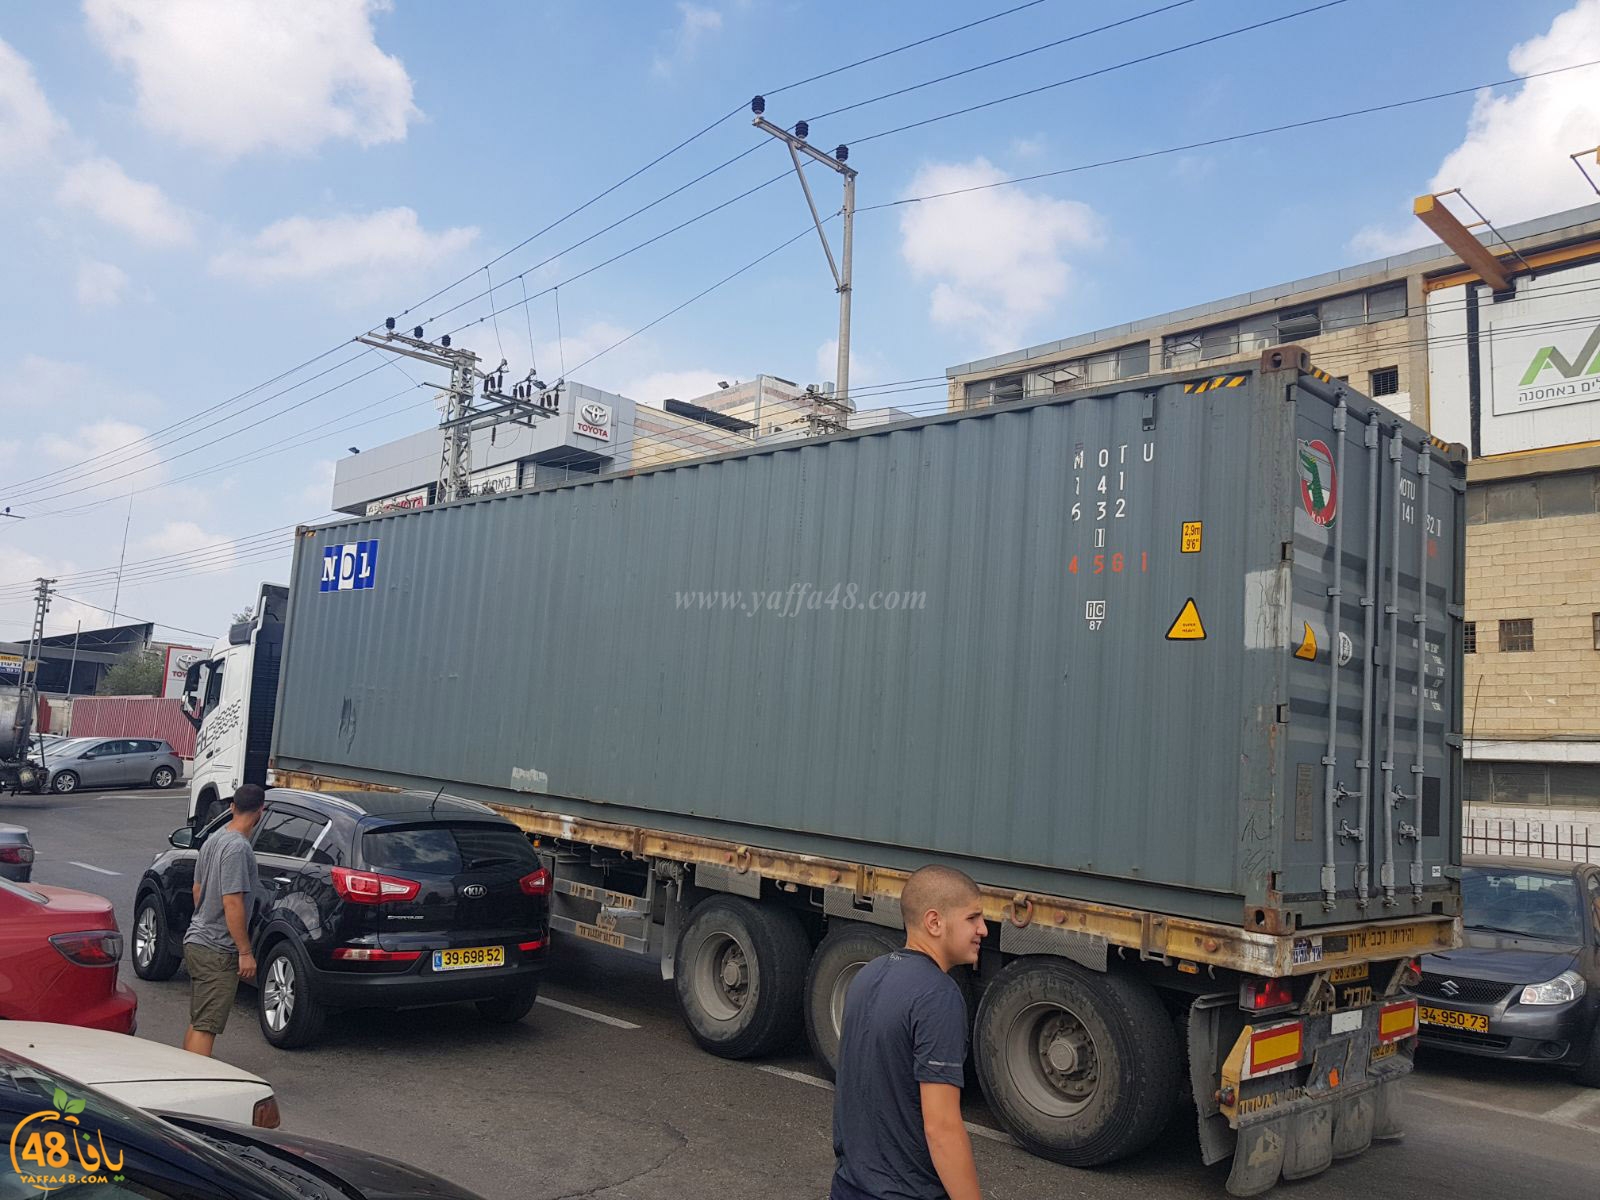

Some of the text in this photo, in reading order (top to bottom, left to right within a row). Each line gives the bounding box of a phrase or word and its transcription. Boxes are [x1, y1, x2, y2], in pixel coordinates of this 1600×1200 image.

[1519, 384, 1576, 402] באחסנה
[577, 422, 609, 438] TOYOTA
[1073, 442, 1154, 470] MOTU
[1071, 498, 1126, 521] 632
[1402, 502, 1414, 525] 141
[321, 552, 371, 582] NDL
[1089, 620, 1102, 631] 87
[468, 886, 485, 896] KIA
